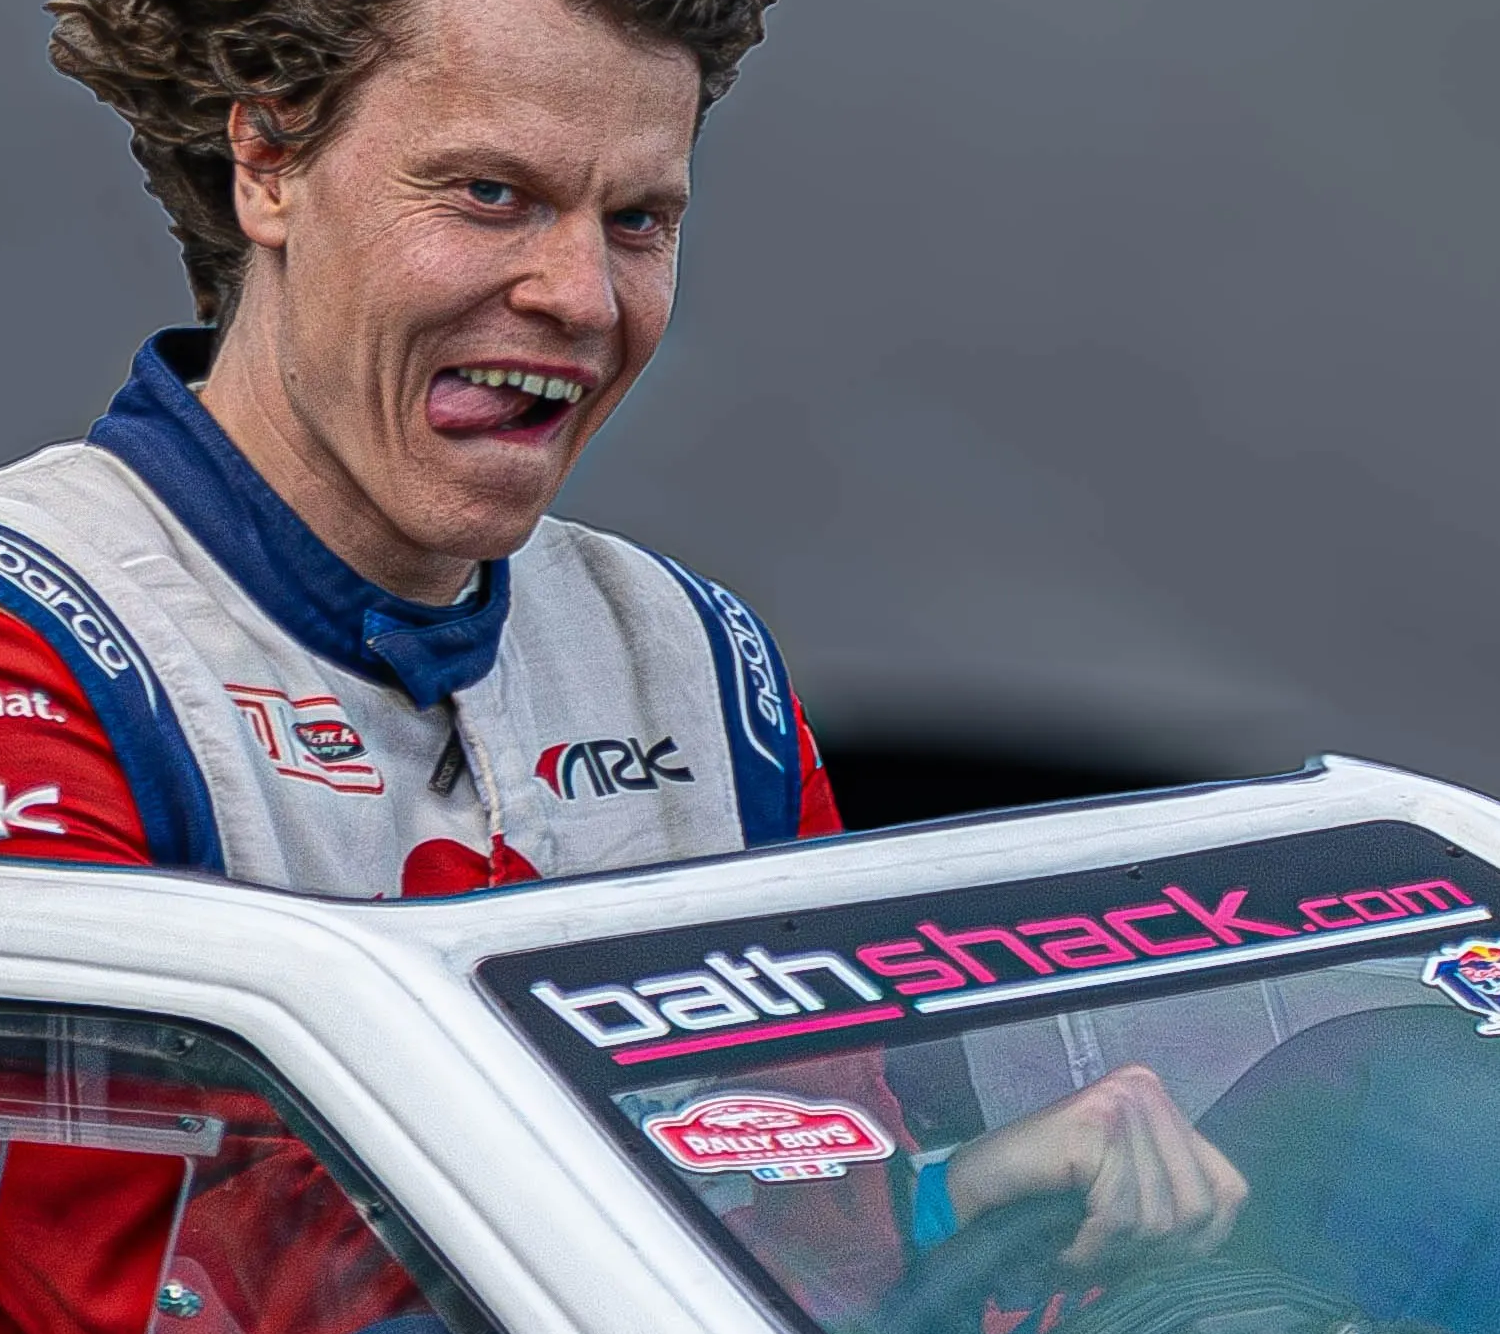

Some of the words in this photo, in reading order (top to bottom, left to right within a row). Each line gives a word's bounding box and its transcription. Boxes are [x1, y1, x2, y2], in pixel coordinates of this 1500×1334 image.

[560, 735, 696, 800] ARK
[528, 878, 1475, 1049] bathshack.com
[681, 1133, 774, 1157] RALLY
[774, 1123, 858, 1149] BOYS
